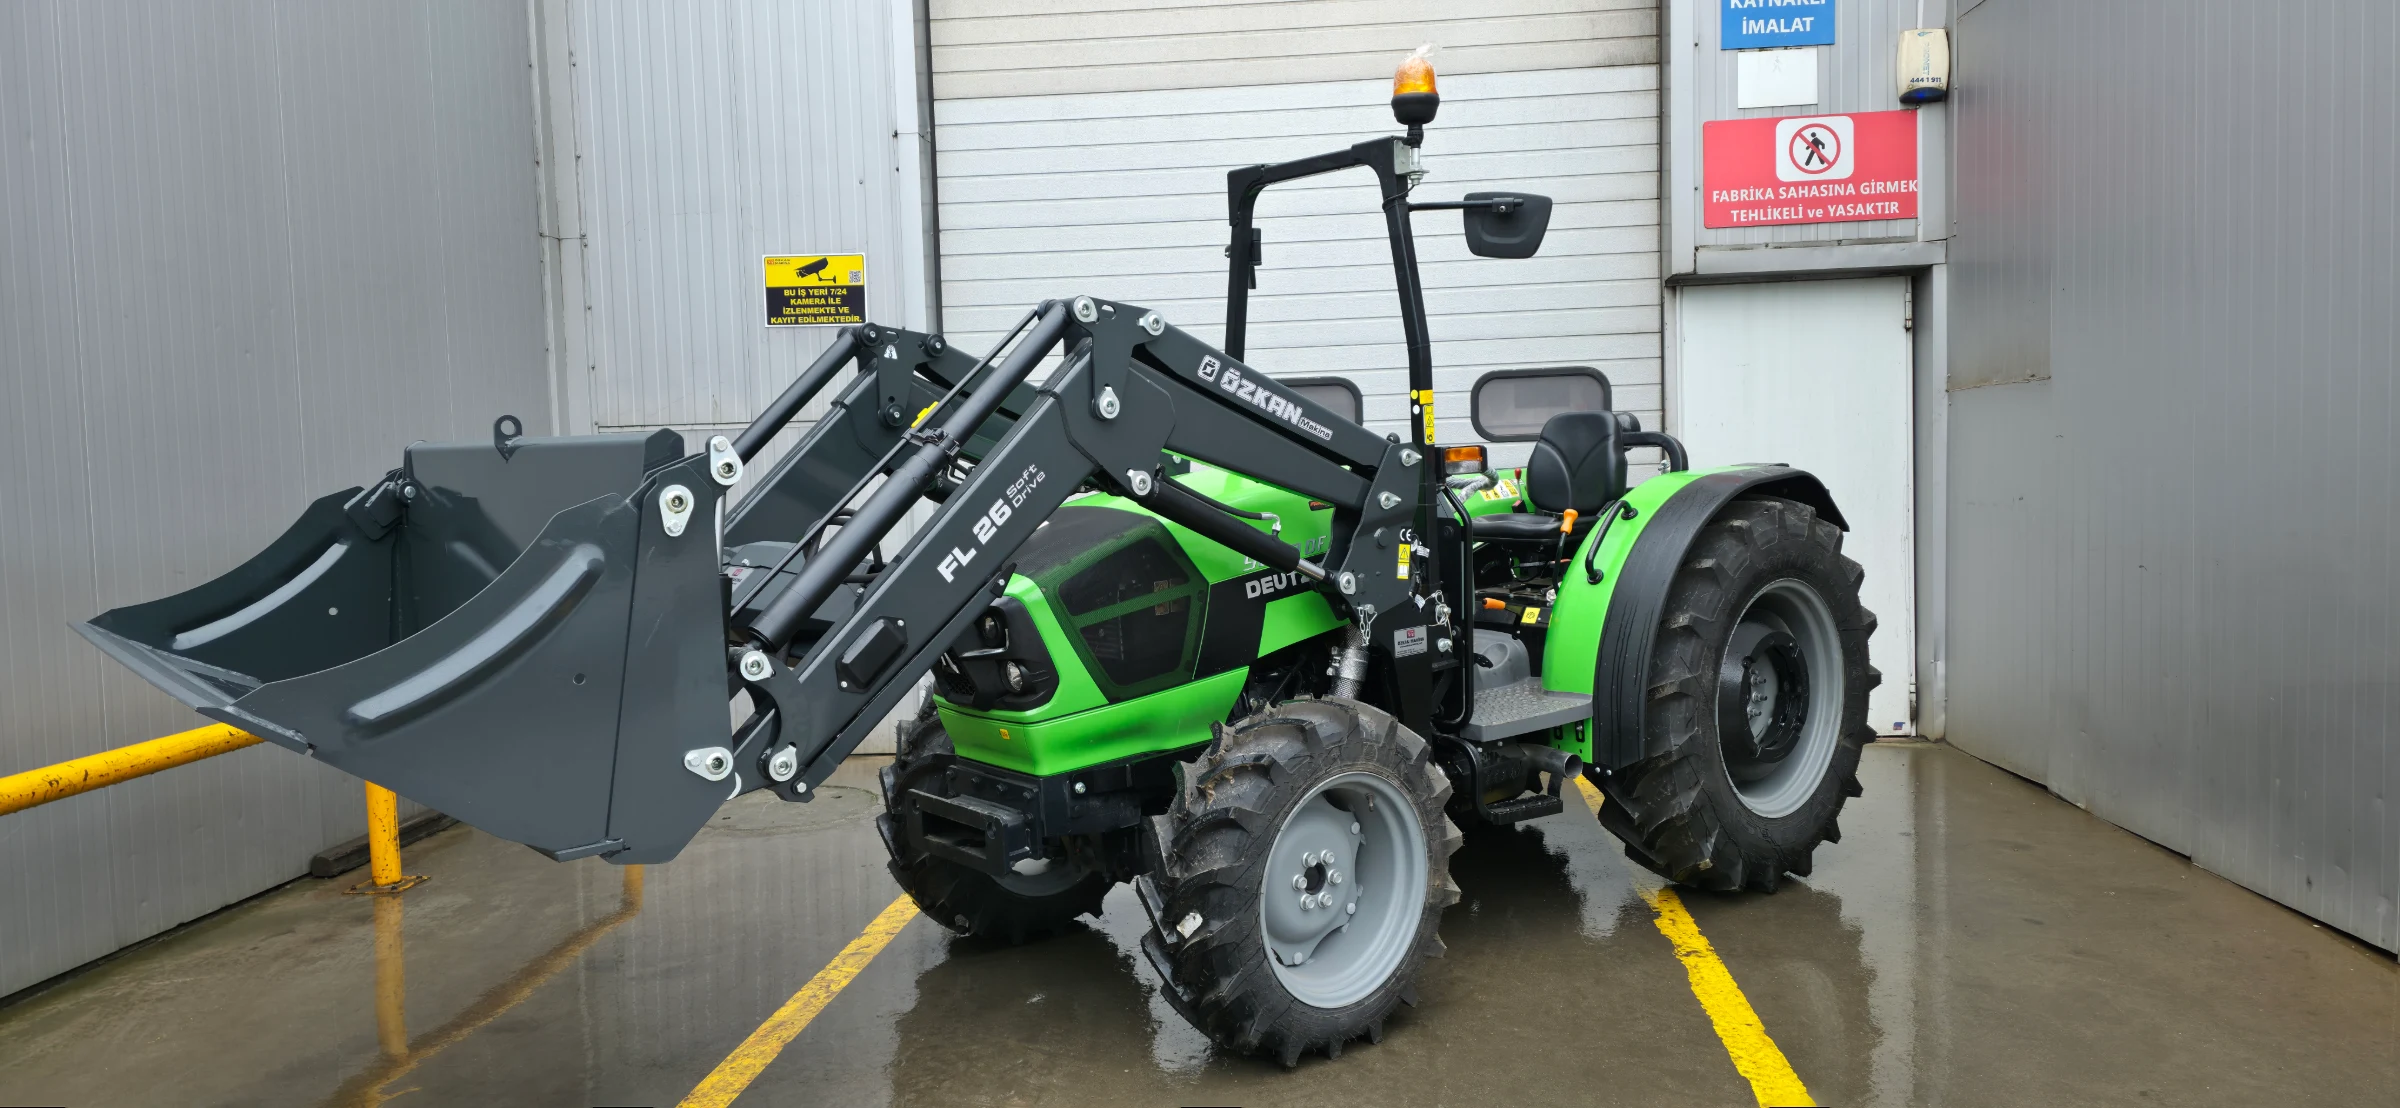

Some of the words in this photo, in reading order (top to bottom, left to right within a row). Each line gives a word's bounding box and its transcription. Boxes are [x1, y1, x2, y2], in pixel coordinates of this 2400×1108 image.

[1742, 16, 1815, 35] İMALAT
[1712, 185, 1775, 203] FABRİKA
[1778, 182, 1856, 200] SAHASINA
[1860, 179, 1918, 195] GİRMEK
[1731, 203, 1803, 222] TEHLİKELİ
[1807, 207, 1823, 218] ve
[1828, 201, 1900, 217] YASAKTIR
[790, 298, 826, 306] KAMERA
[828, 296, 841, 305] İLE
[798, 288, 806, 297] İŞ
[808, 287, 828, 296] YERİ
[783, 306, 836, 315] İZLENMEKTE
[838, 306, 850, 314] VE
[798, 315, 862, 323] EDİLMEKTEDİR.
[1219, 367, 1303, 425] ÖZKAN
[1300, 417, 1332, 440] Makina
[1005, 463, 1038, 499] Soft
[1012, 471, 1046, 508] Drive
[936, 546, 978, 583] FL
[972, 498, 1012, 545] 26
